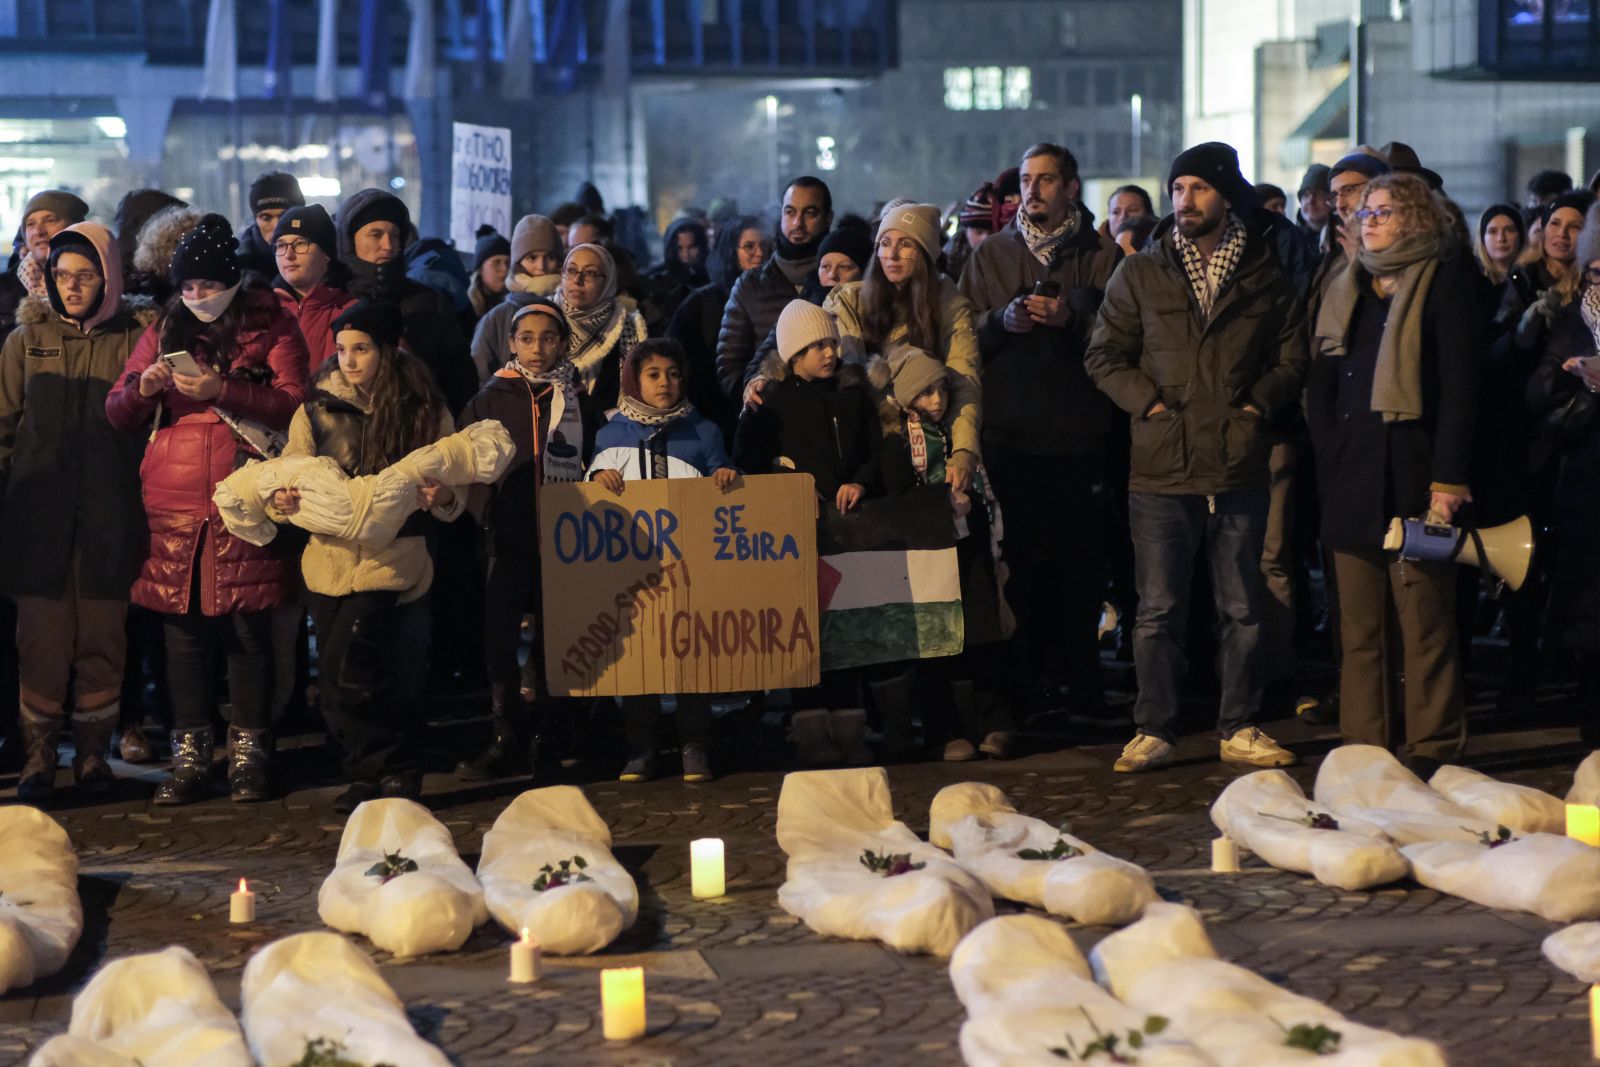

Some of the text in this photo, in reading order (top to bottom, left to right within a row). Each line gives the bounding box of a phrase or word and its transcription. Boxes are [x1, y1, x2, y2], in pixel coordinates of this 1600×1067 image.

[554, 508, 682, 564] ODBOR
[712, 504, 747, 535] SE
[713, 531, 799, 561] ZBIRA
[614, 560, 692, 621] SMRTI
[659, 606, 815, 659] IGNORIRA
